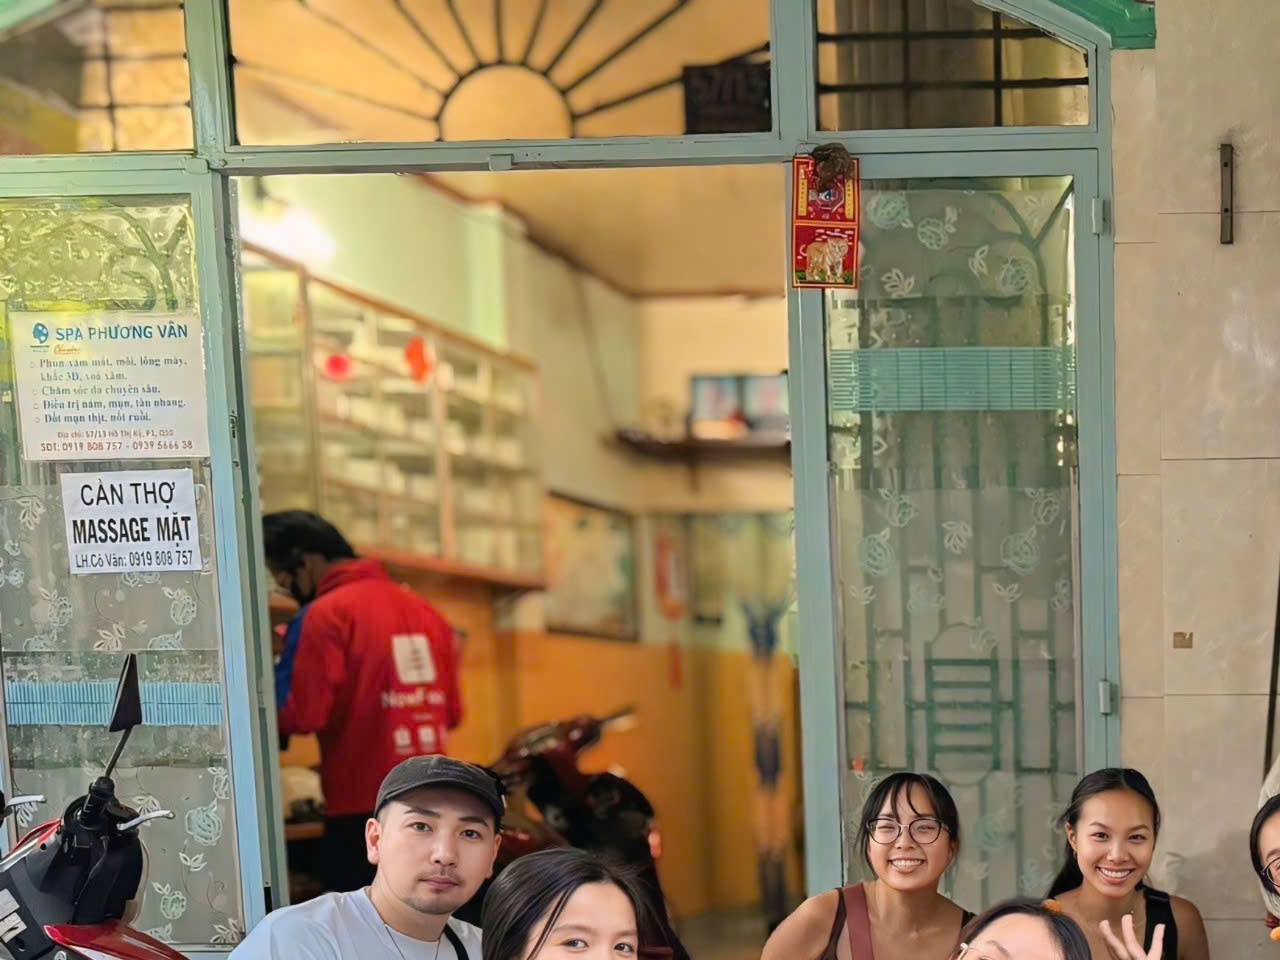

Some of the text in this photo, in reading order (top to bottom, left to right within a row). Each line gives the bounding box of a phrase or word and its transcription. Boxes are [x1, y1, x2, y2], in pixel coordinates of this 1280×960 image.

[56, 320, 188, 340] SPA PHƯƠNG VÂN
[40, 359, 65, 368] Phun
[91, 385, 102, 394] da
[62, 442, 84, 451] 0919
[87, 441, 104, 451] 808
[105, 441, 122, 450] 757
[132, 441, 155, 450] 0939
[129, 481, 176, 509] THỢ
[72, 511, 191, 548] MASSAGE MẶT
[129, 551, 152, 566] 0919
[154, 550, 173, 565] 808
[175, 550, 193, 565] 757
